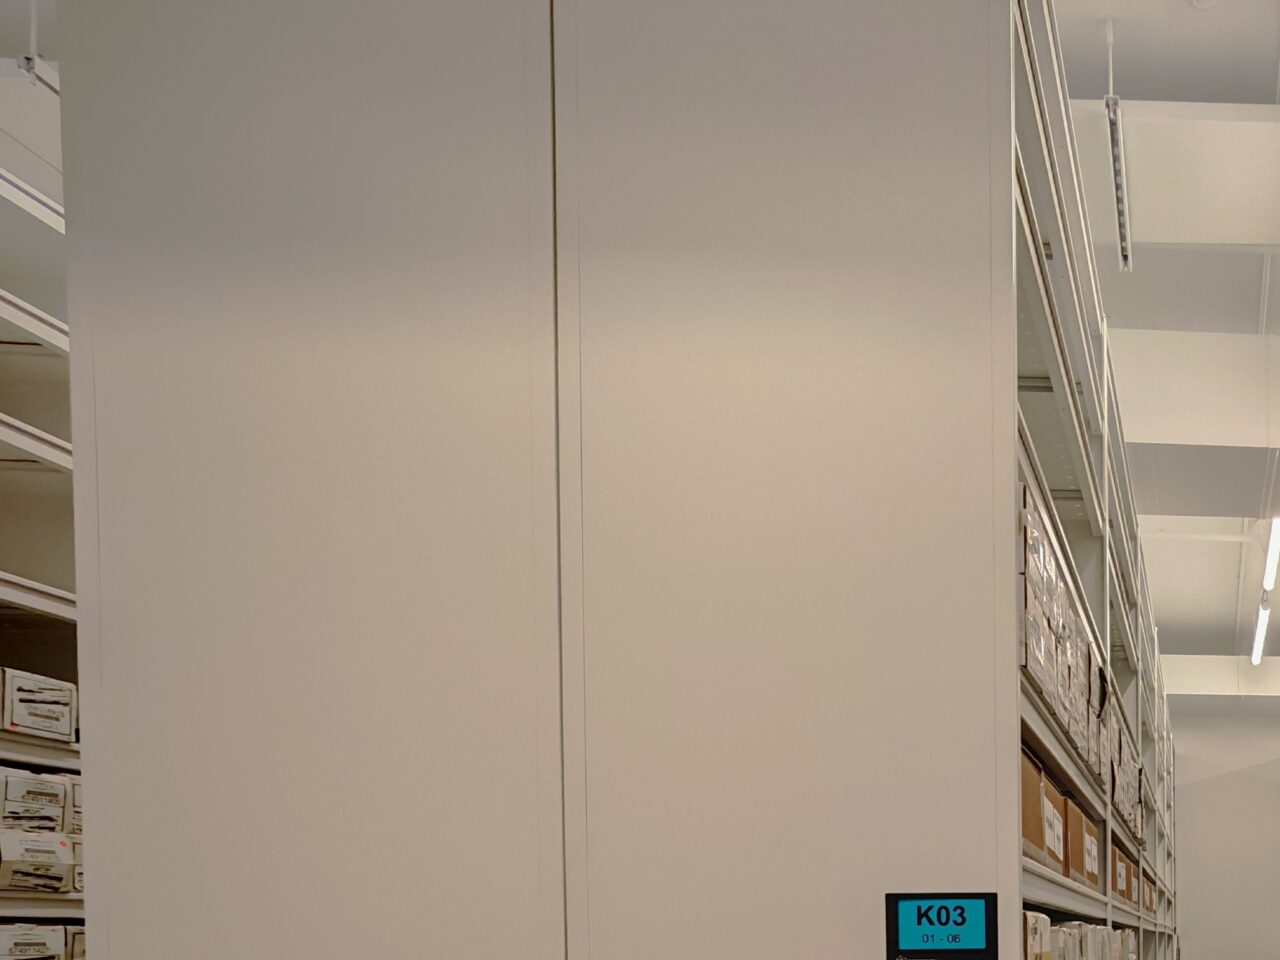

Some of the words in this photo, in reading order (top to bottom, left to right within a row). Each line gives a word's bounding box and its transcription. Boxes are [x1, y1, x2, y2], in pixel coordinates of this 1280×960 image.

[917, 905, 966, 927] K03
[922, 934, 935, 943] 01
[947, 934, 961, 943] 06
